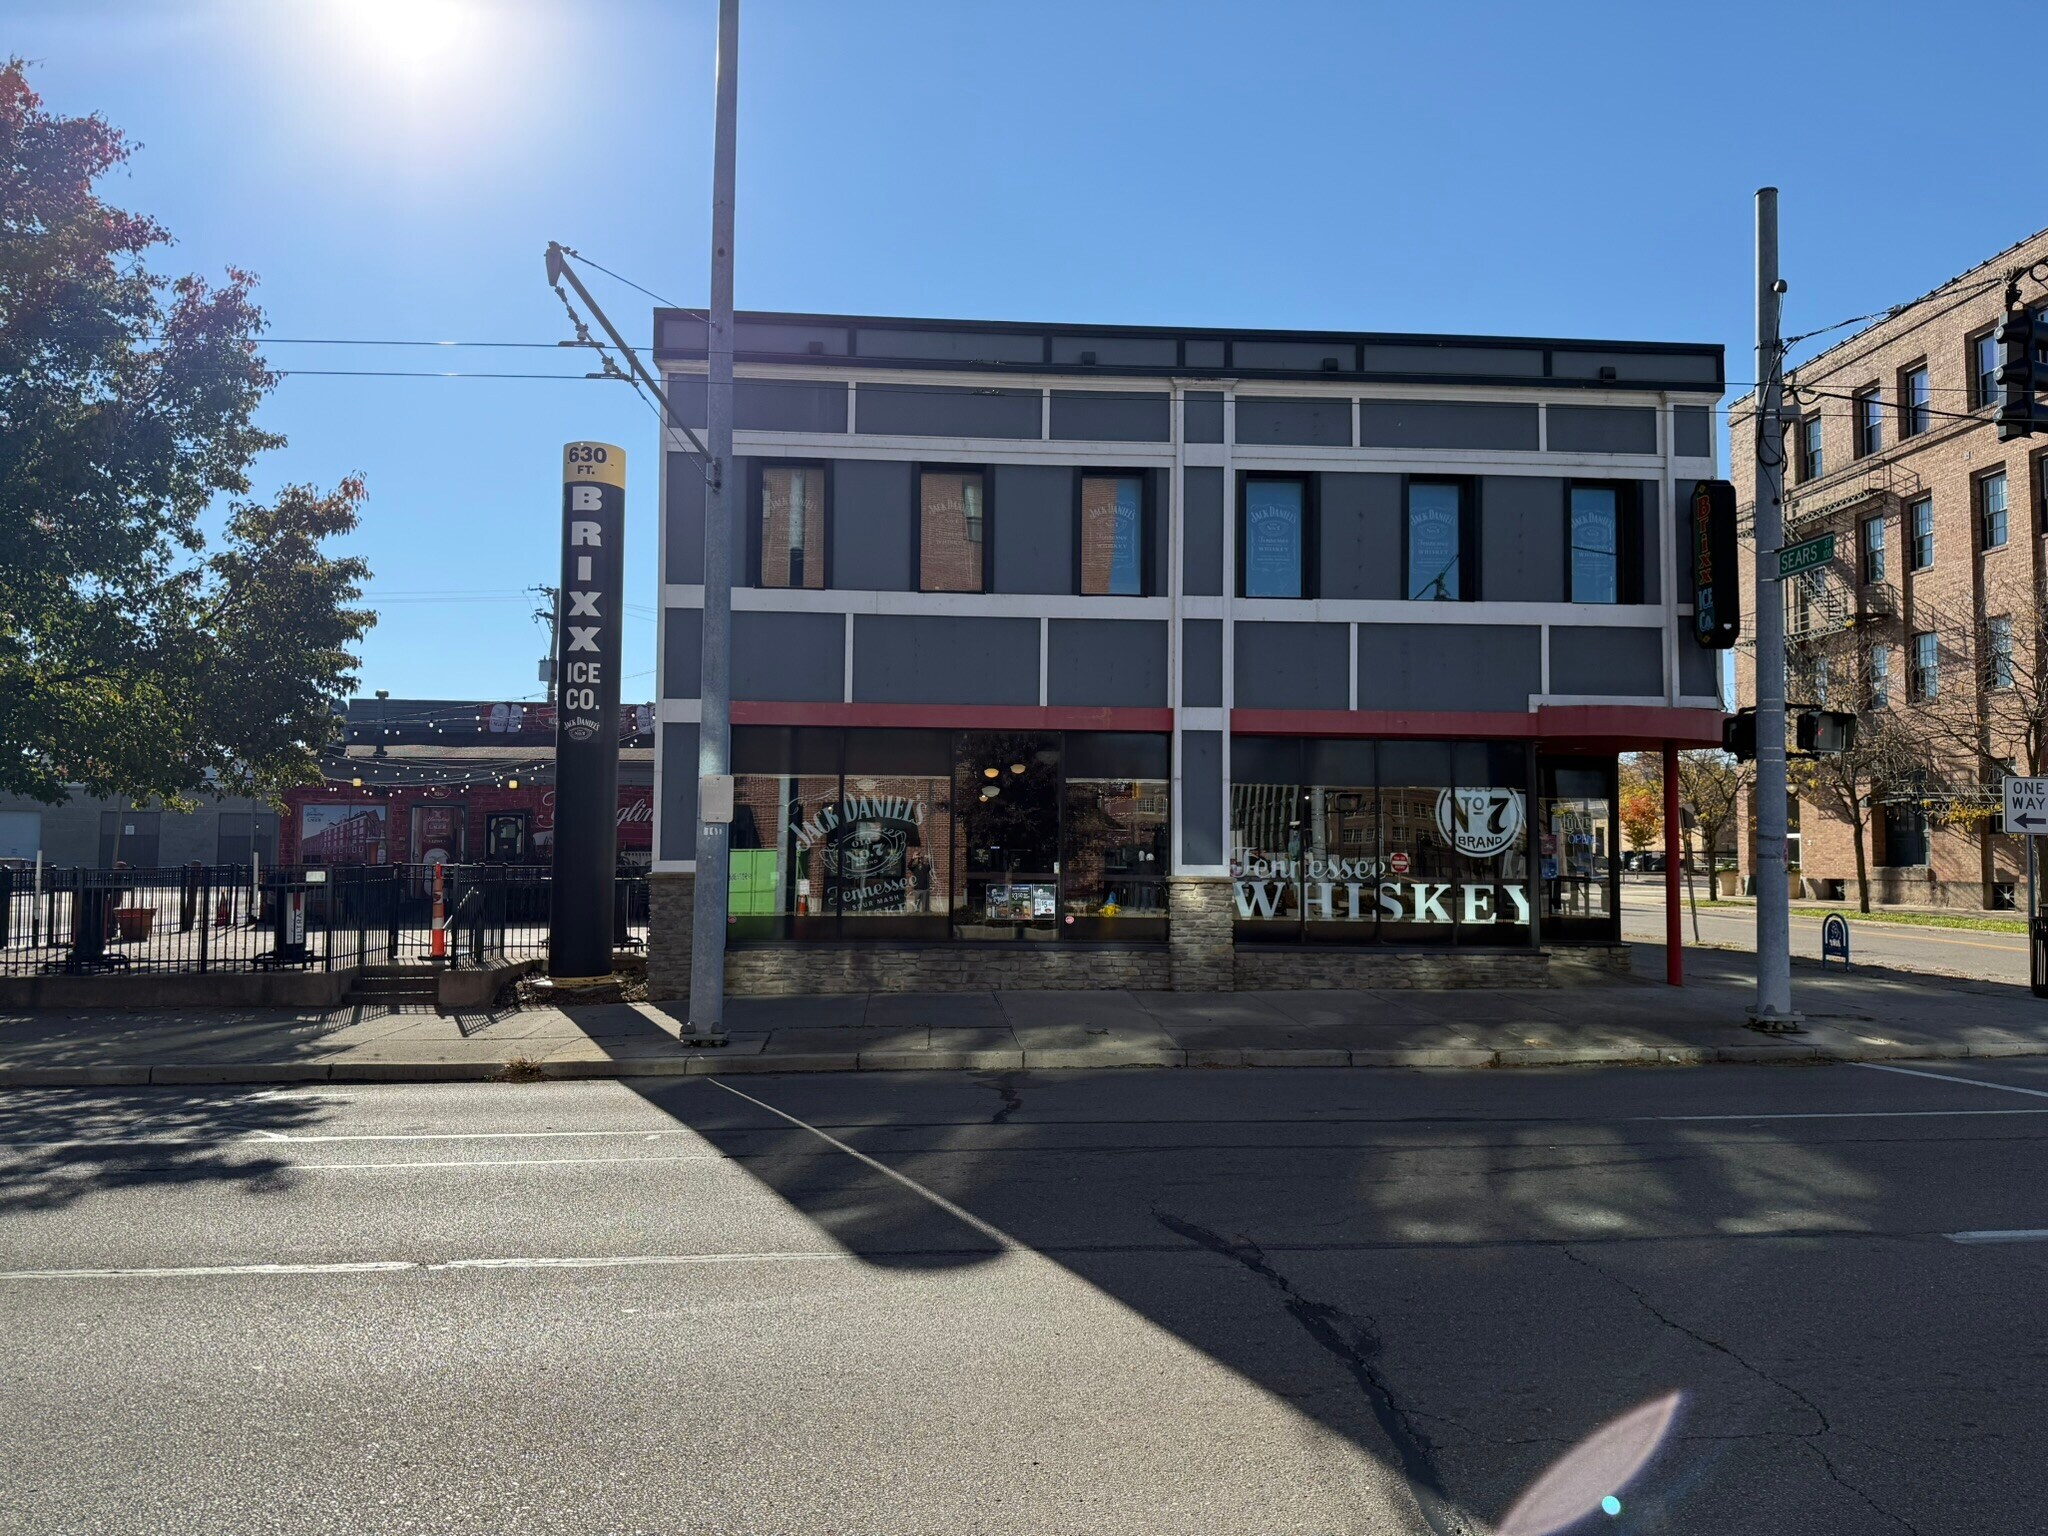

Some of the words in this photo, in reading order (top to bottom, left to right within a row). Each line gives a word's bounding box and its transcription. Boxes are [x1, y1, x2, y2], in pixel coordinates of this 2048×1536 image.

[569, 446, 608, 464] 630
[577, 465, 595, 475] FT.
[1250, 509, 1270, 523] JACK
[1781, 545, 1818, 571] SEARS
[568, 486, 603, 652] BRIXX
[567, 661, 602, 683] ICE
[566, 688, 600, 710] CO.
[563, 718, 577, 731] JACK
[2013, 781, 2045, 795] ONE
[2012, 797, 2046, 810] WAY
[789, 803, 840, 852] JACK
[843, 791, 927, 827] DANIEL'S
[1457, 835, 1503, 850] BRAND
[1568, 833, 1596, 845] OPEN
[1229, 846, 1386, 880] Tennessee
[827, 875, 918, 906] Tennessee
[852, 901, 875, 911] SOUR
[876, 895, 900, 905] MASH
[1233, 882, 1531, 925] WHISKEY
